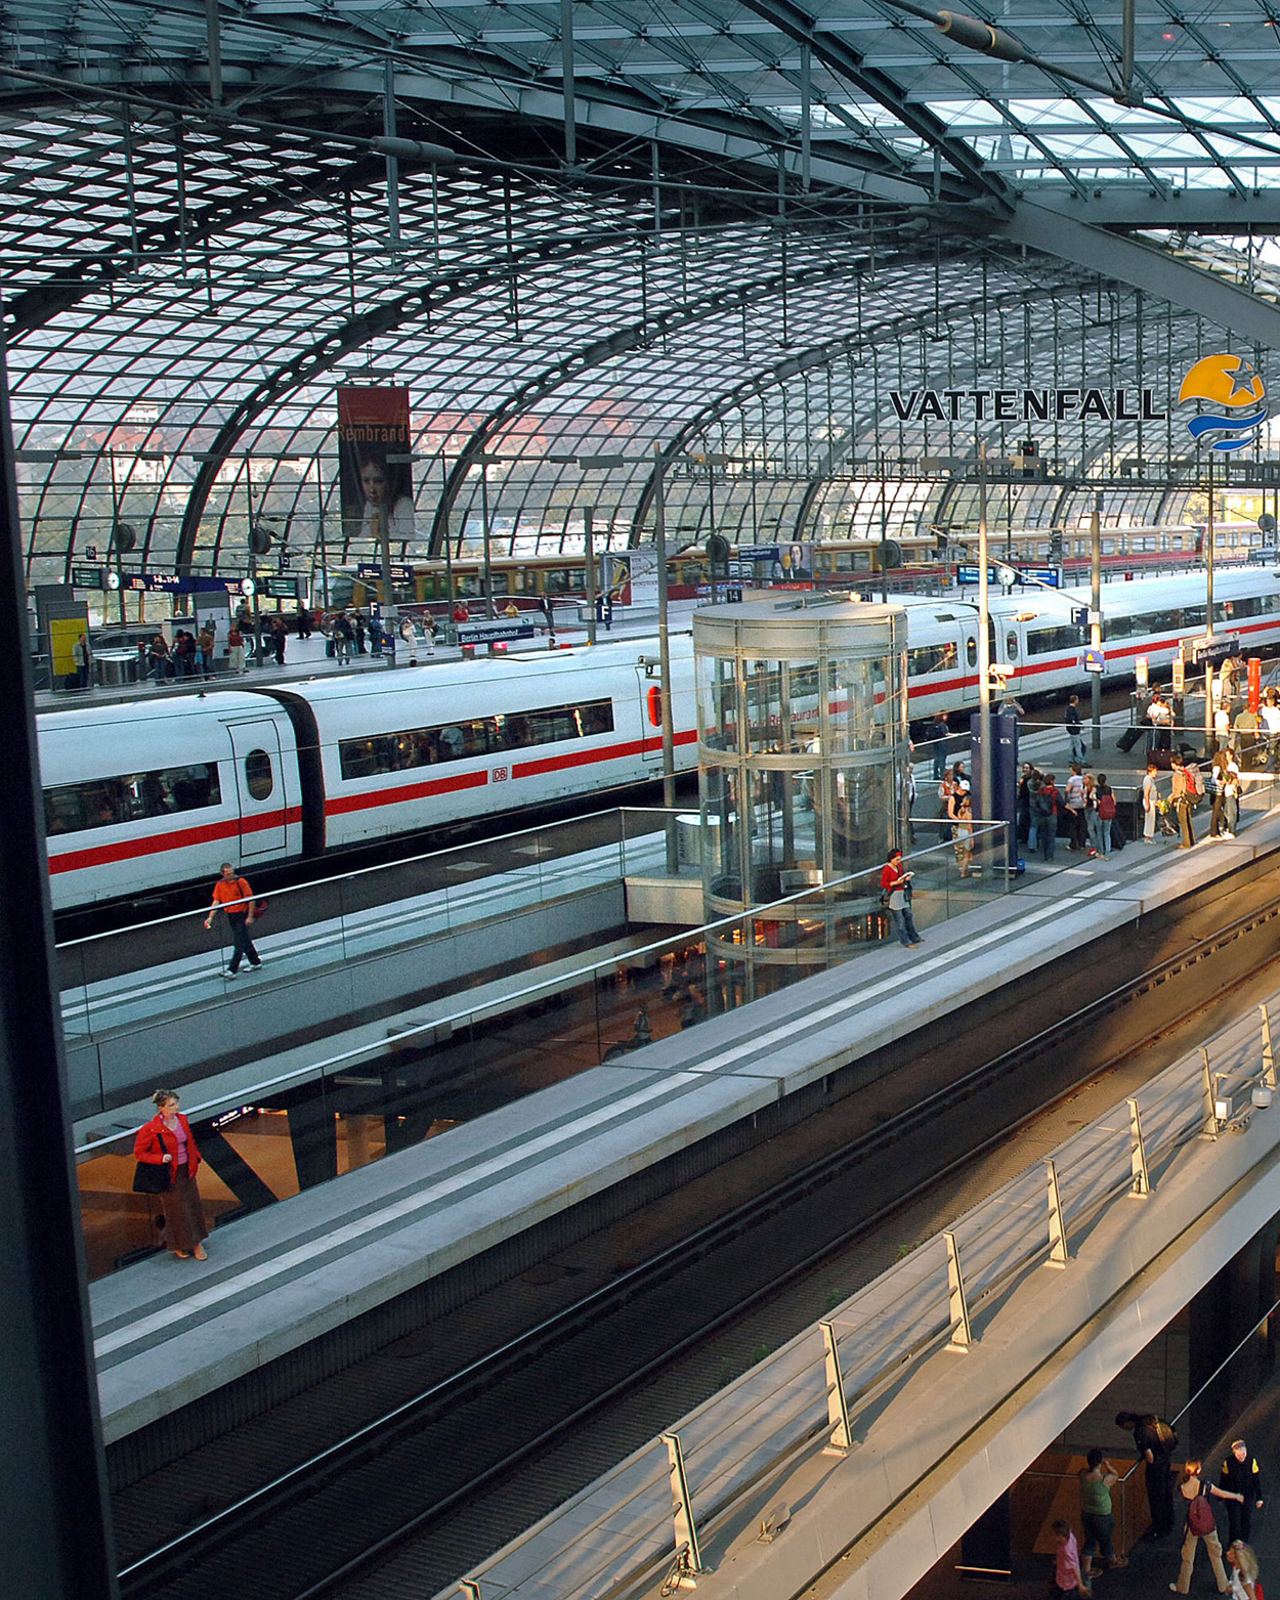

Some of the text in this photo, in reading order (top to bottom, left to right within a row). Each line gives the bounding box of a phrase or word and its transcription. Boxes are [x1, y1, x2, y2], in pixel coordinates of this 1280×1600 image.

[889, 389, 1167, 421] VATTENFALL
[728, 590, 738, 601] 14
[370, 602, 378, 616] F
[602, 606, 609, 620] F
[1072, 608, 1082, 622] F
[462, 629, 518, 642] Berlin Hauptbahnhof
